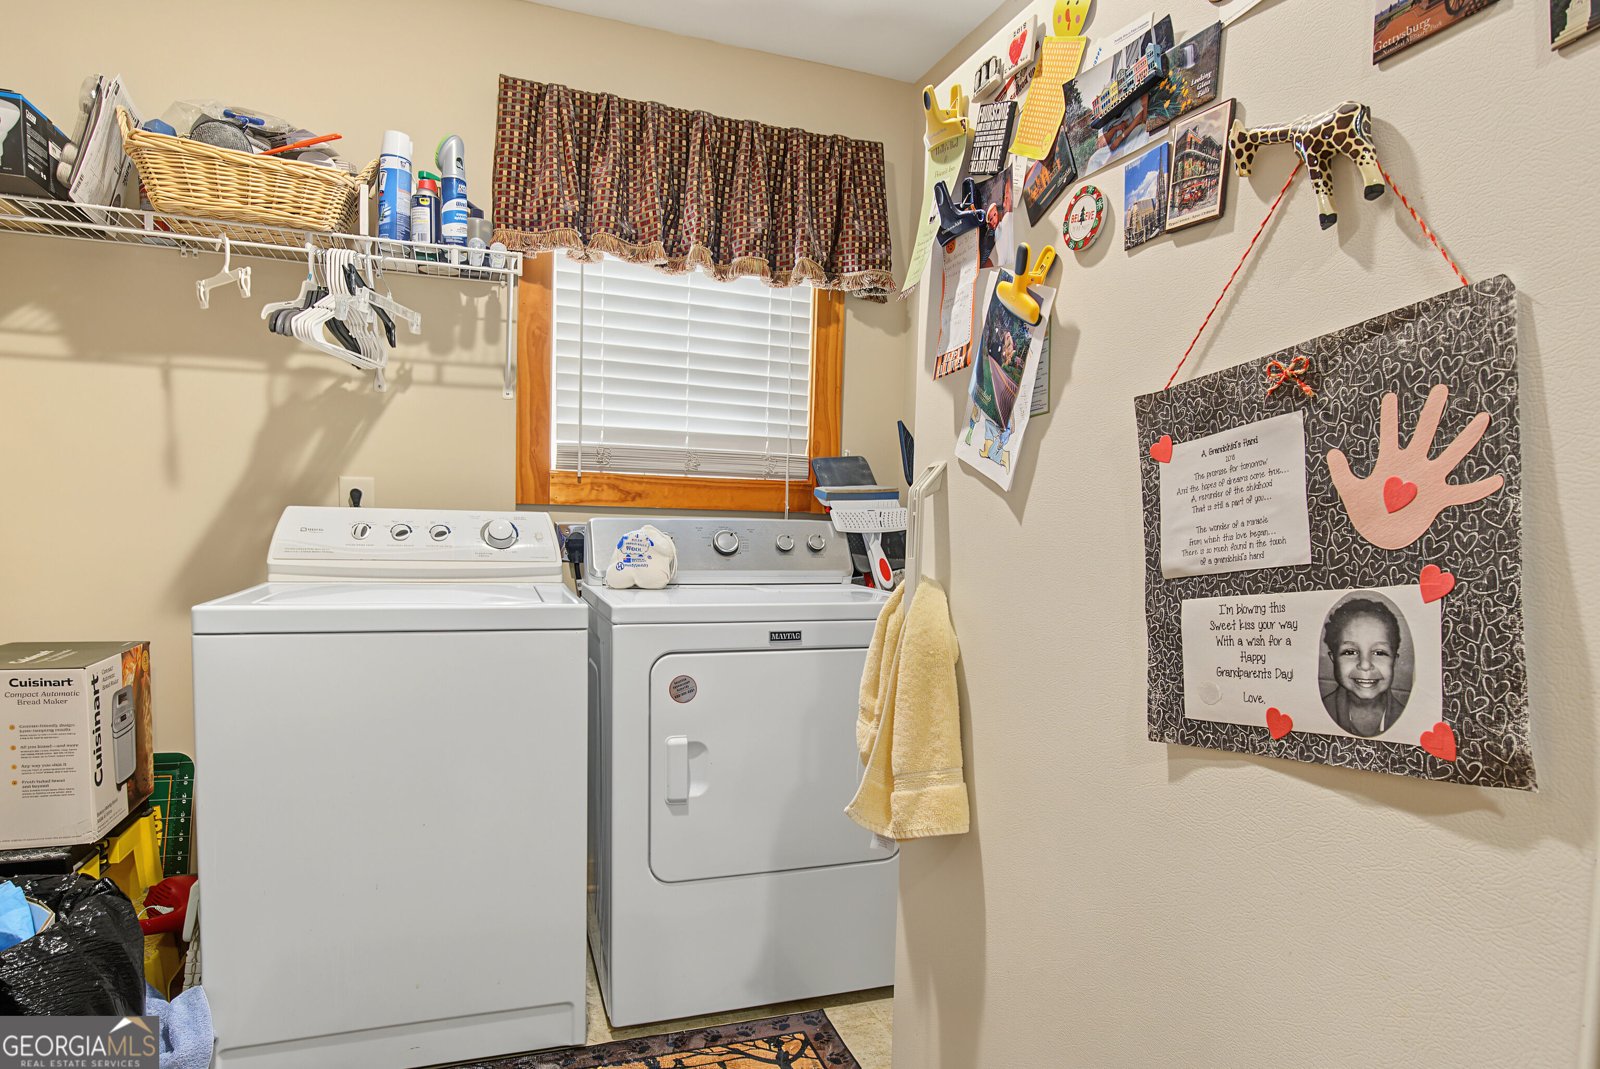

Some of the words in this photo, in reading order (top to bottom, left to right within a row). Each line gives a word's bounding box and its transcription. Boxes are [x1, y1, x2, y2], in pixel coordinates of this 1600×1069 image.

[1374, 17, 1431, 51] Gettysburg
[1191, 70, 1213, 87] Looking
[1198, 87, 1210, 98] Falls
[1209, 441, 1241, 456] Grandchild's
[1243, 436, 1258, 447] Hand
[1206, 468, 1228, 479] promise
[1230, 465, 1238, 474] for
[1176, 487, 1188, 496] And
[1190, 485, 1200, 494] the
[1201, 481, 1217, 491] hopes
[1218, 478, 1226, 487] of
[1226, 474, 1248, 485] dreams
[1198, 490, 1224, 501] reminder
[1225, 488, 1232, 496] of
[1234, 486, 1244, 494] the
[1246, 479, 1272, 492] childhood
[1192, 505, 1206, 514] That
[1232, 496, 1244, 508] part
[1246, 495, 1252, 504] of
[1209, 522, 1230, 532] wonder
[1232, 520, 1238, 528] of
[1246, 516, 1268, 526] miracle
[1204, 535, 1220, 543] which
[1222, 533, 1234, 541] this
[1236, 532, 1247, 540] love
[1214, 544, 1228, 552] much
[1230, 542, 1247, 552] found
[1256, 540, 1266, 548] the
[1270, 536, 1286, 546] touch
[1214, 554, 1247, 565] grandchild's
[1249, 552, 1265, 560] hand
[1219, 604, 1234, 615] I'm
[1236, 604, 1266, 616] blowing
[1269, 602, 1286, 613] this
[1210, 620, 1236, 630] Sweet
[1239, 619, 1255, 630] kiss
[1258, 621, 1276, 632] your
[1279, 620, 1298, 631] way
[1216, 635, 1234, 646] With
[1238, 638, 1243, 646] a
[1246, 635, 1265, 646] wish
[1268, 634, 1282, 646] for
[1286, 638, 1292, 646] a
[1240, 651, 1266, 664] Happy
[1216, 667, 1272, 679] Grandparents
[1275, 668, 1294, 682] Day!
[9, 678, 73, 687] Cuisinart
[91, 674, 103, 787] Cuisinart
